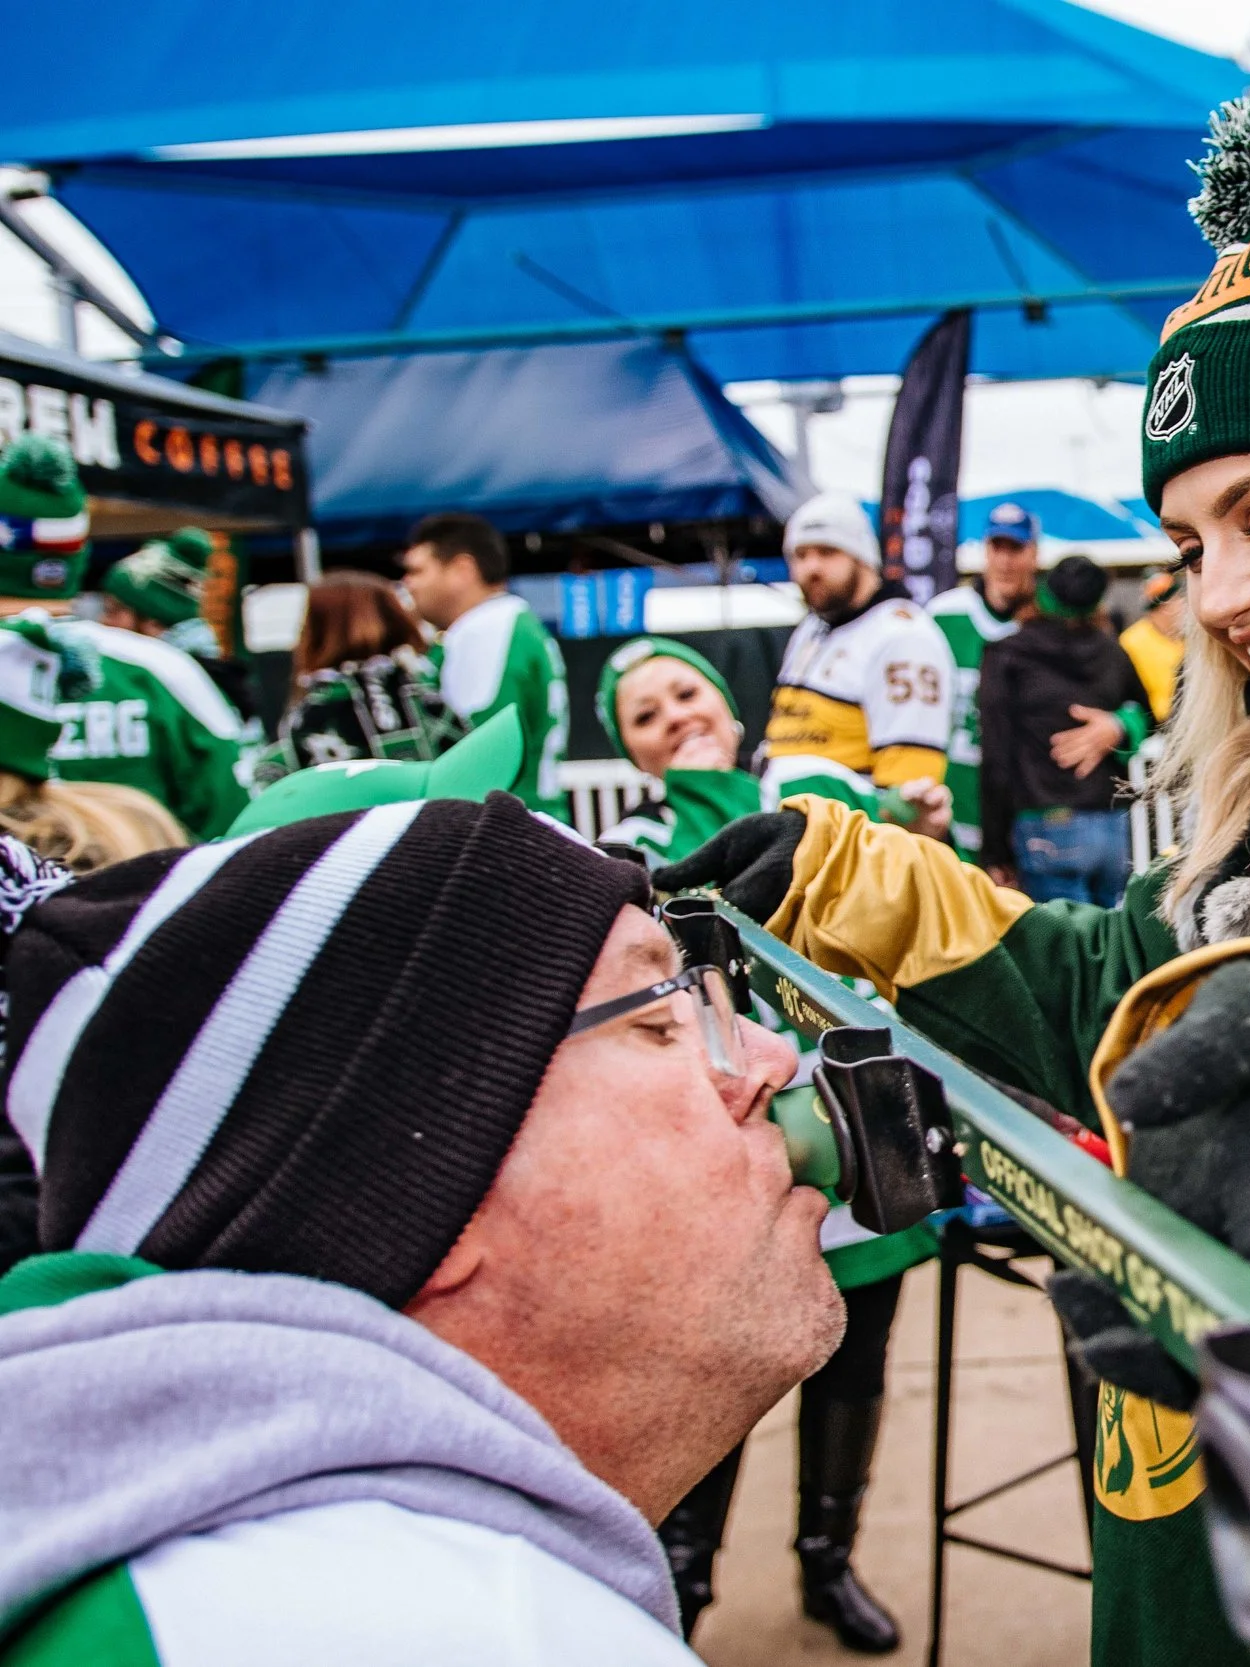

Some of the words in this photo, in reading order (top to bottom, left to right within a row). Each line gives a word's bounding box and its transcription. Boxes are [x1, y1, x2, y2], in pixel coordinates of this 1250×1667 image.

[1155, 376, 1185, 426] NHL
[134, 419, 293, 491] COFFEE
[884, 660, 941, 706] 59
[47, 699, 150, 761] ERG
[980, 1139, 1065, 1237] OFFICIAL
[1063, 1204, 1124, 1285] SHOT
[1126, 1253, 1161, 1312] OF
